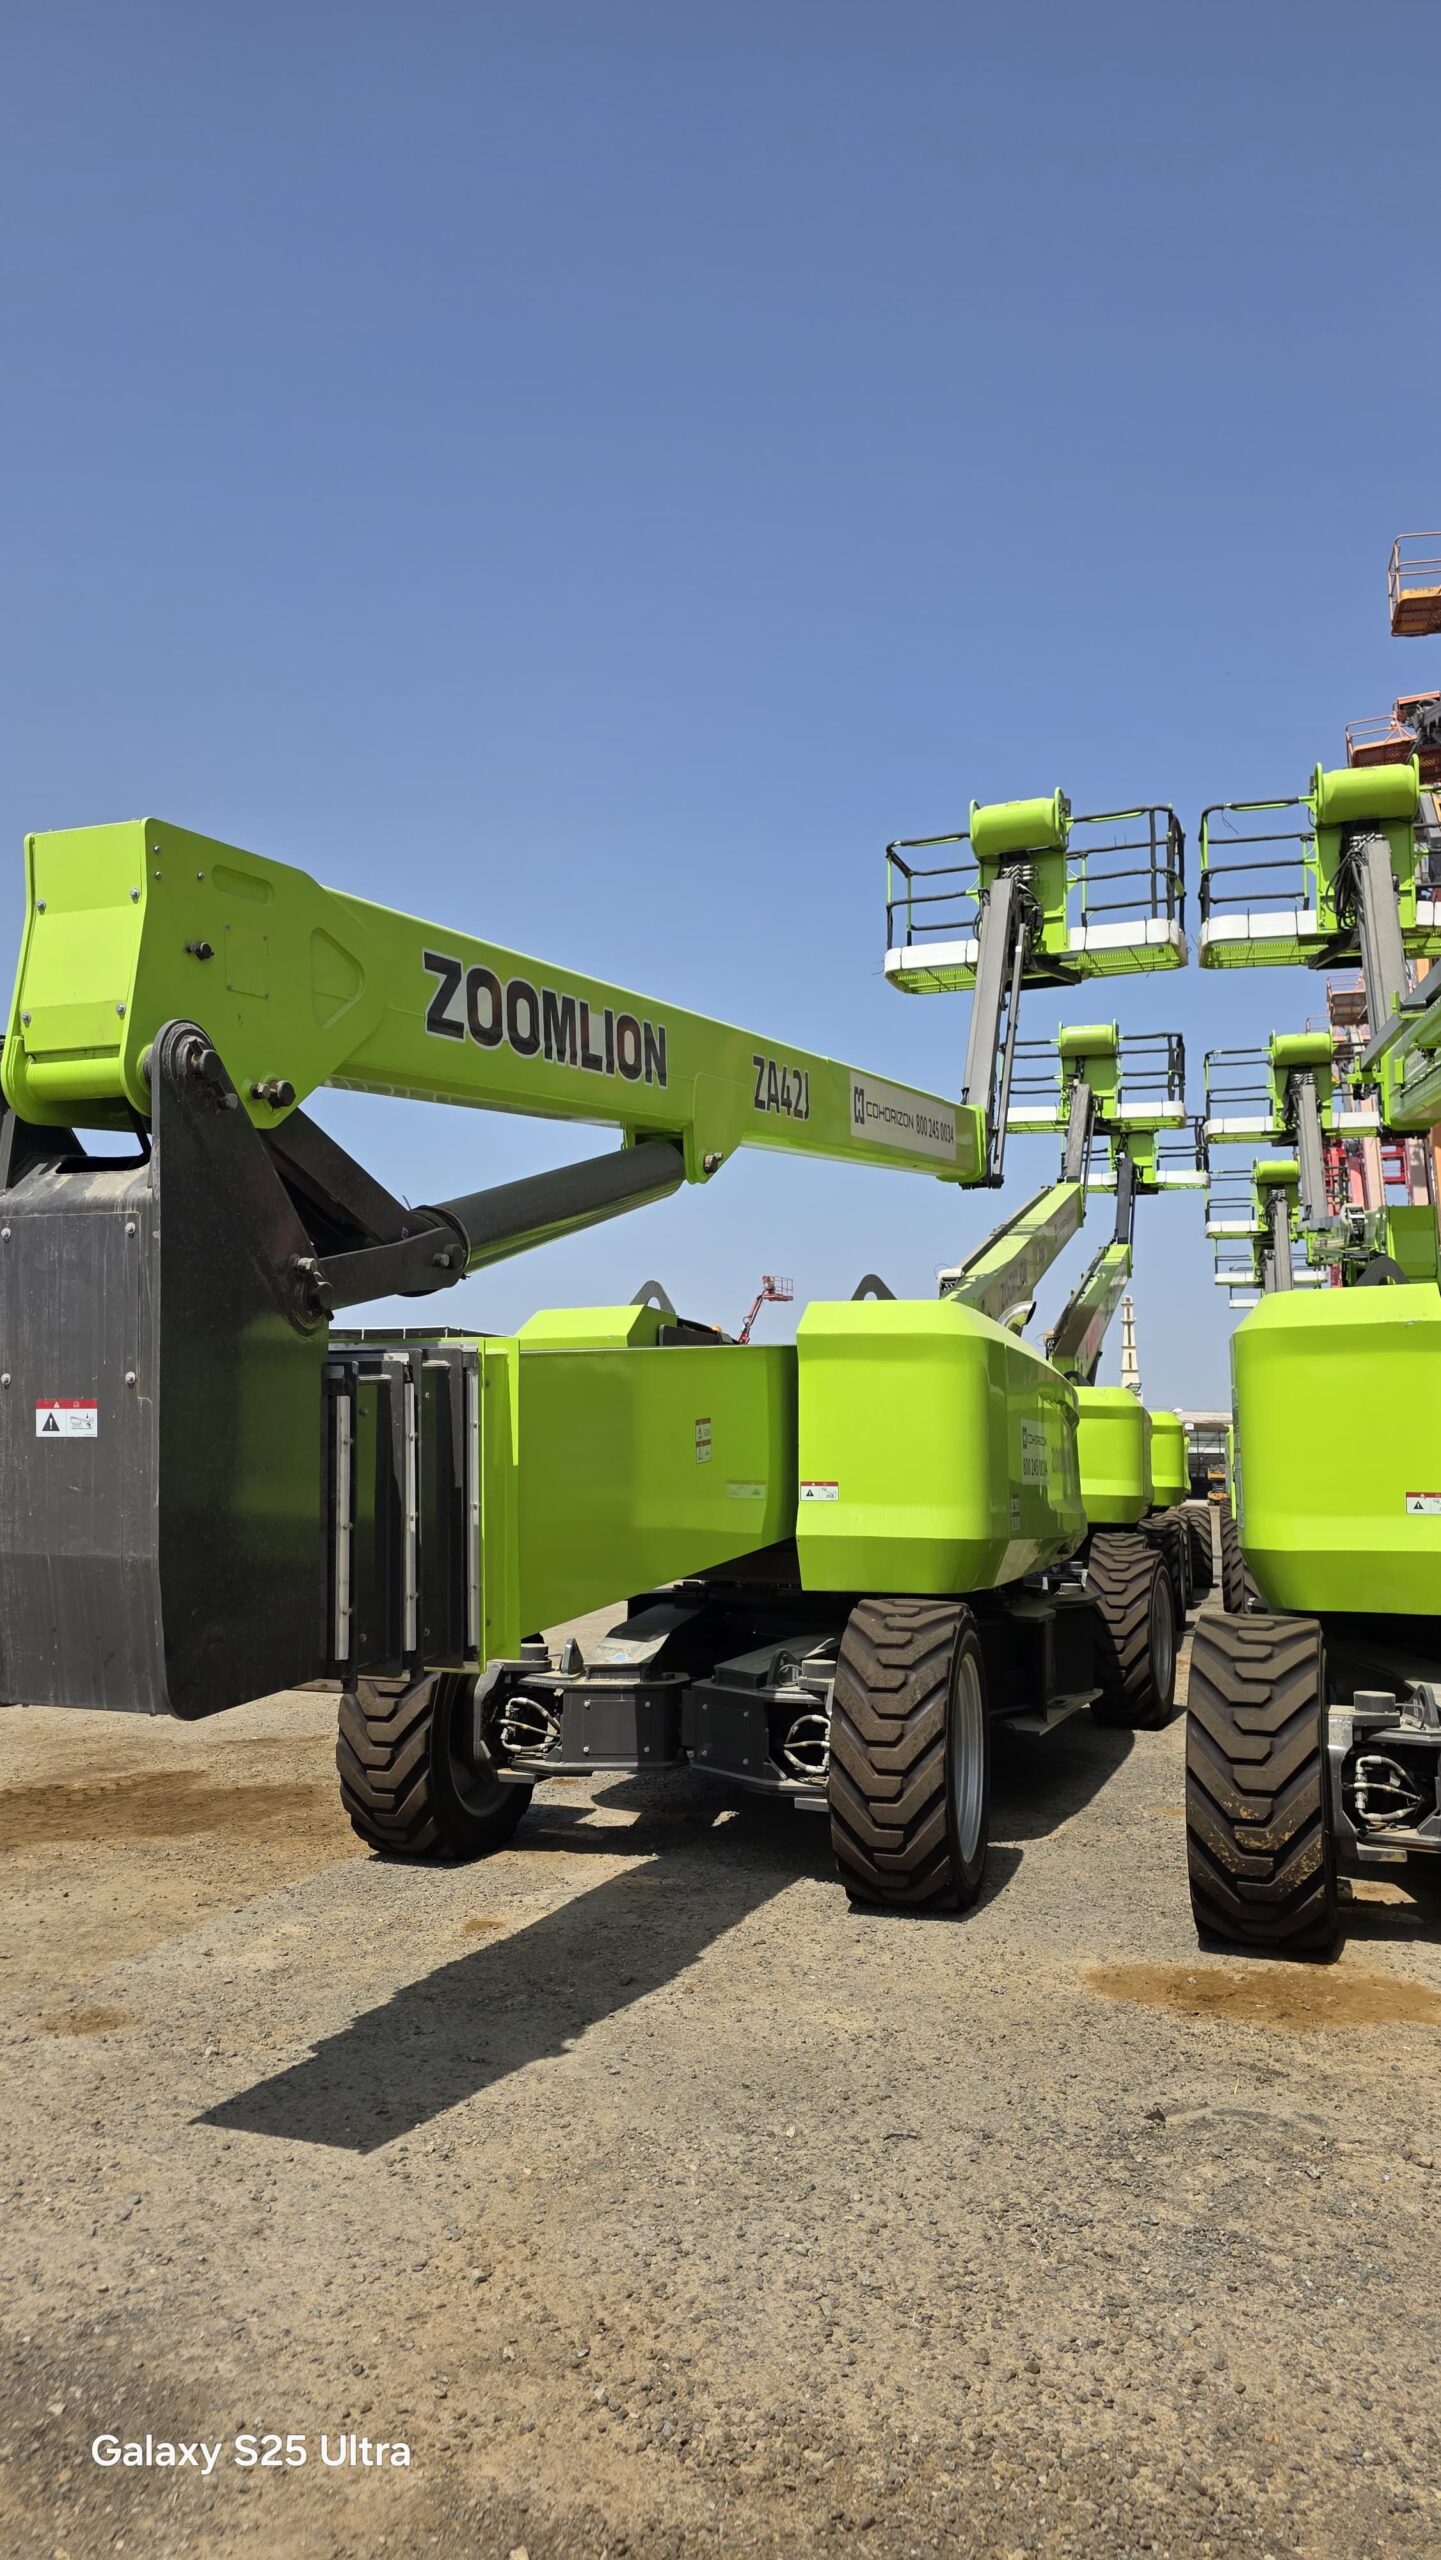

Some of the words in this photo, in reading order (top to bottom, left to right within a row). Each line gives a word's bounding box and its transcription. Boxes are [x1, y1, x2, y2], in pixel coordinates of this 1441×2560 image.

[423, 951, 668, 1087] ZOOMLION
[752, 1054, 810, 1120] ZA42J
[866, 1101, 914, 1129] COHORIZON
[915, 1113, 928, 1137] 800
[929, 1118, 939, 1140] 245
